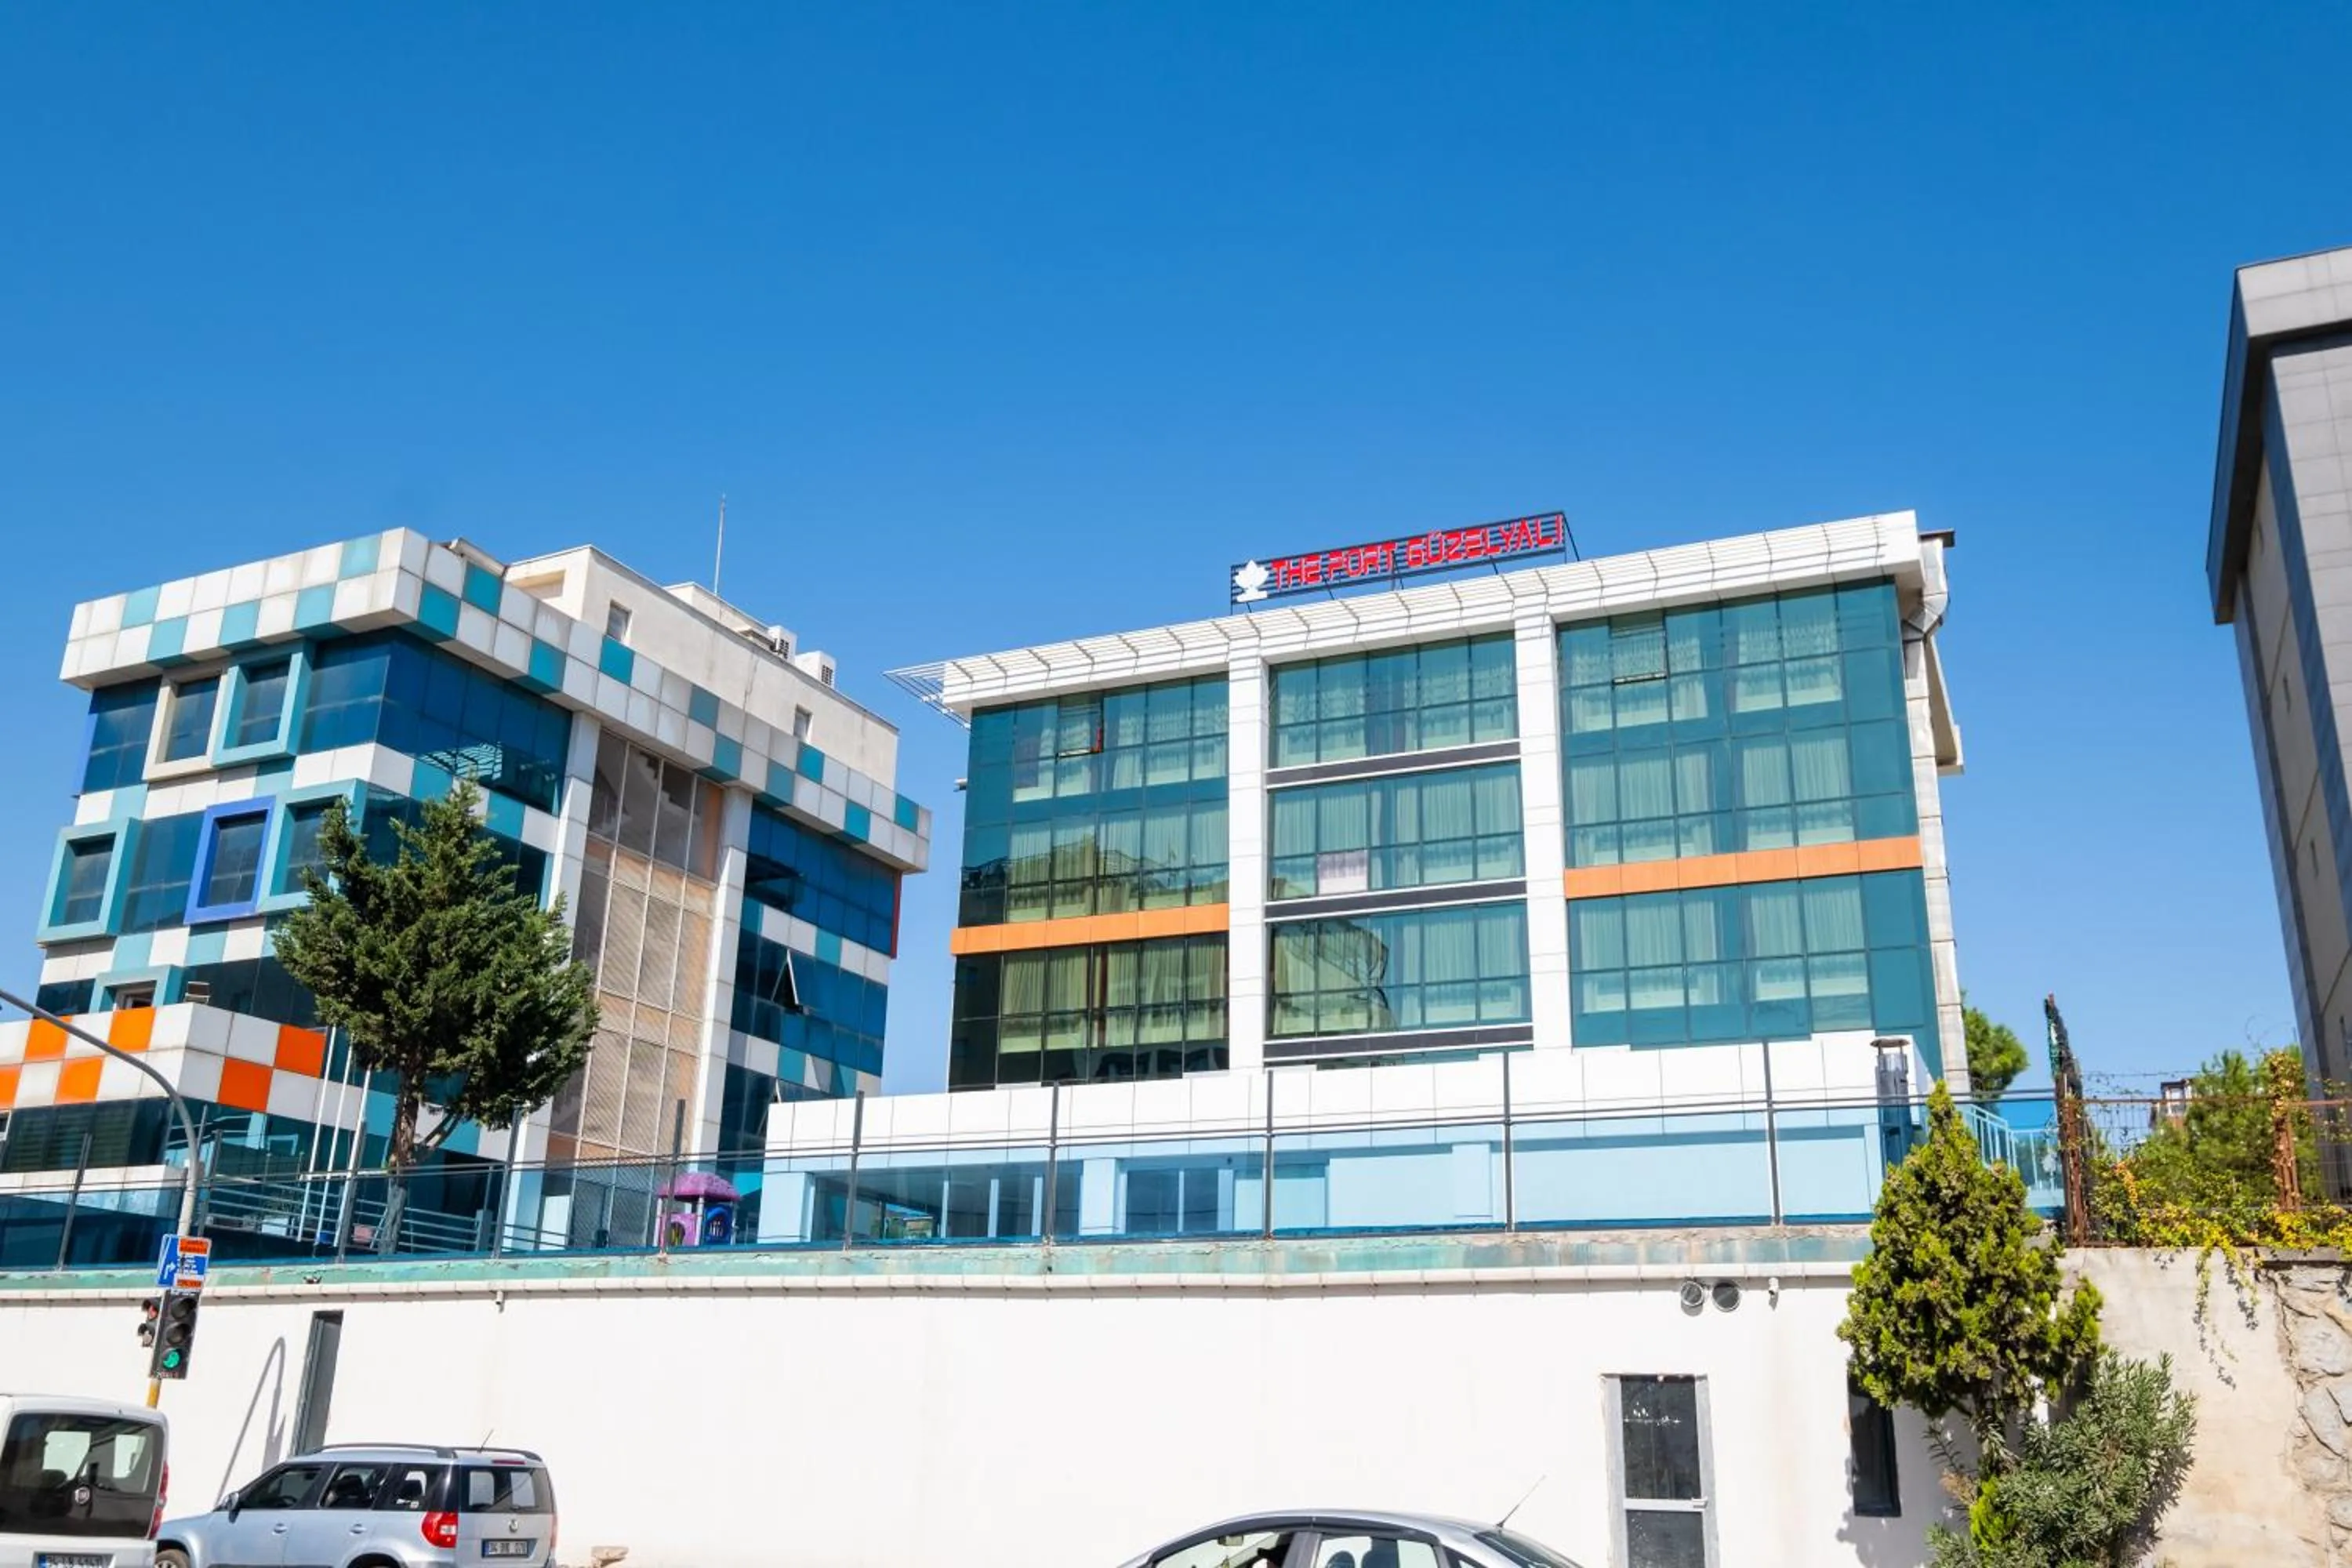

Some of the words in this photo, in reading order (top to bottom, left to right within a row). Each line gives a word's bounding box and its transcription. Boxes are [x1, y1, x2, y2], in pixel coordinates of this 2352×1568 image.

[1271, 554, 1322, 589] THE
[1327, 541, 1397, 580] PORT
[1406, 514, 1563, 568] GÜZELYALI
